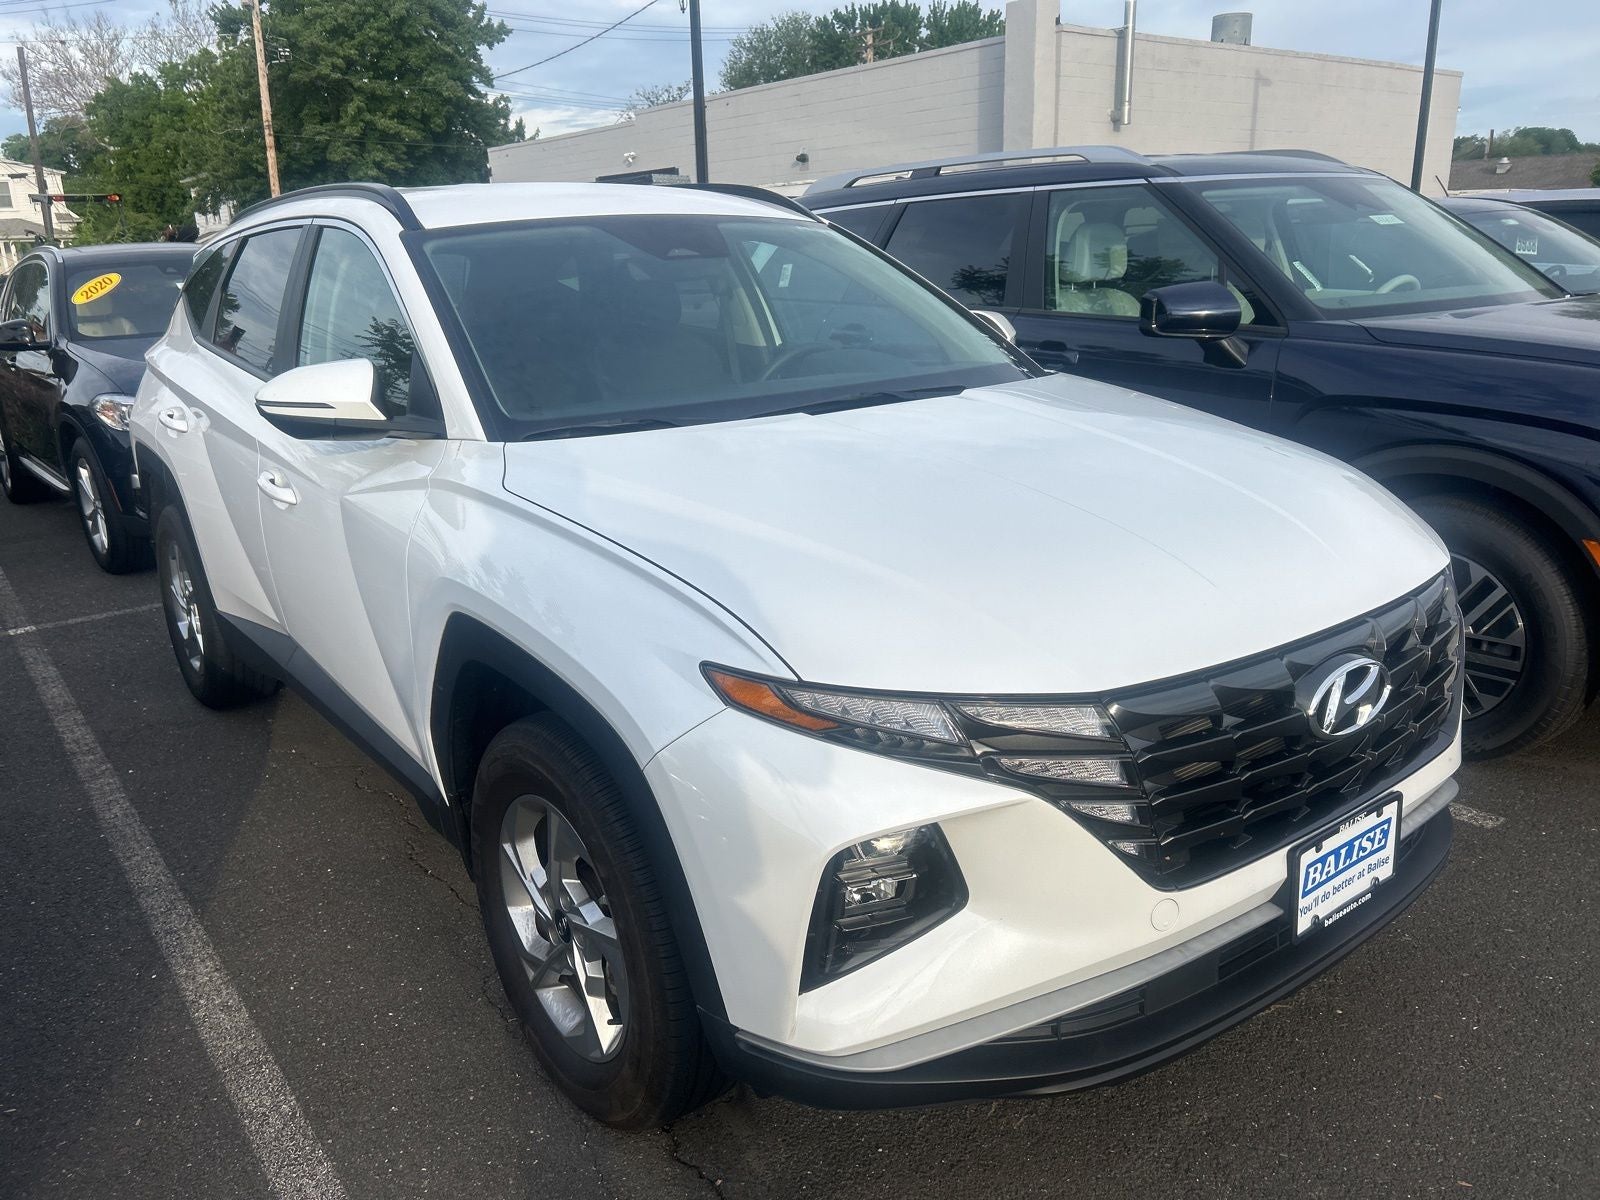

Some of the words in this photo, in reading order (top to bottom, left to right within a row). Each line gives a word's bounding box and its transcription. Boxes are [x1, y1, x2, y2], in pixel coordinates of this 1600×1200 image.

[80, 276, 113, 300] 2020
[1304, 823, 1388, 892] BALISE
[1299, 898, 1320, 918] You'll
[1321, 890, 1331, 903] do
[1332, 874, 1356, 896] better
[1357, 867, 1366, 881] at
[1367, 854, 1390, 874] Balise
[1324, 892, 1372, 928] baliseauto.com
